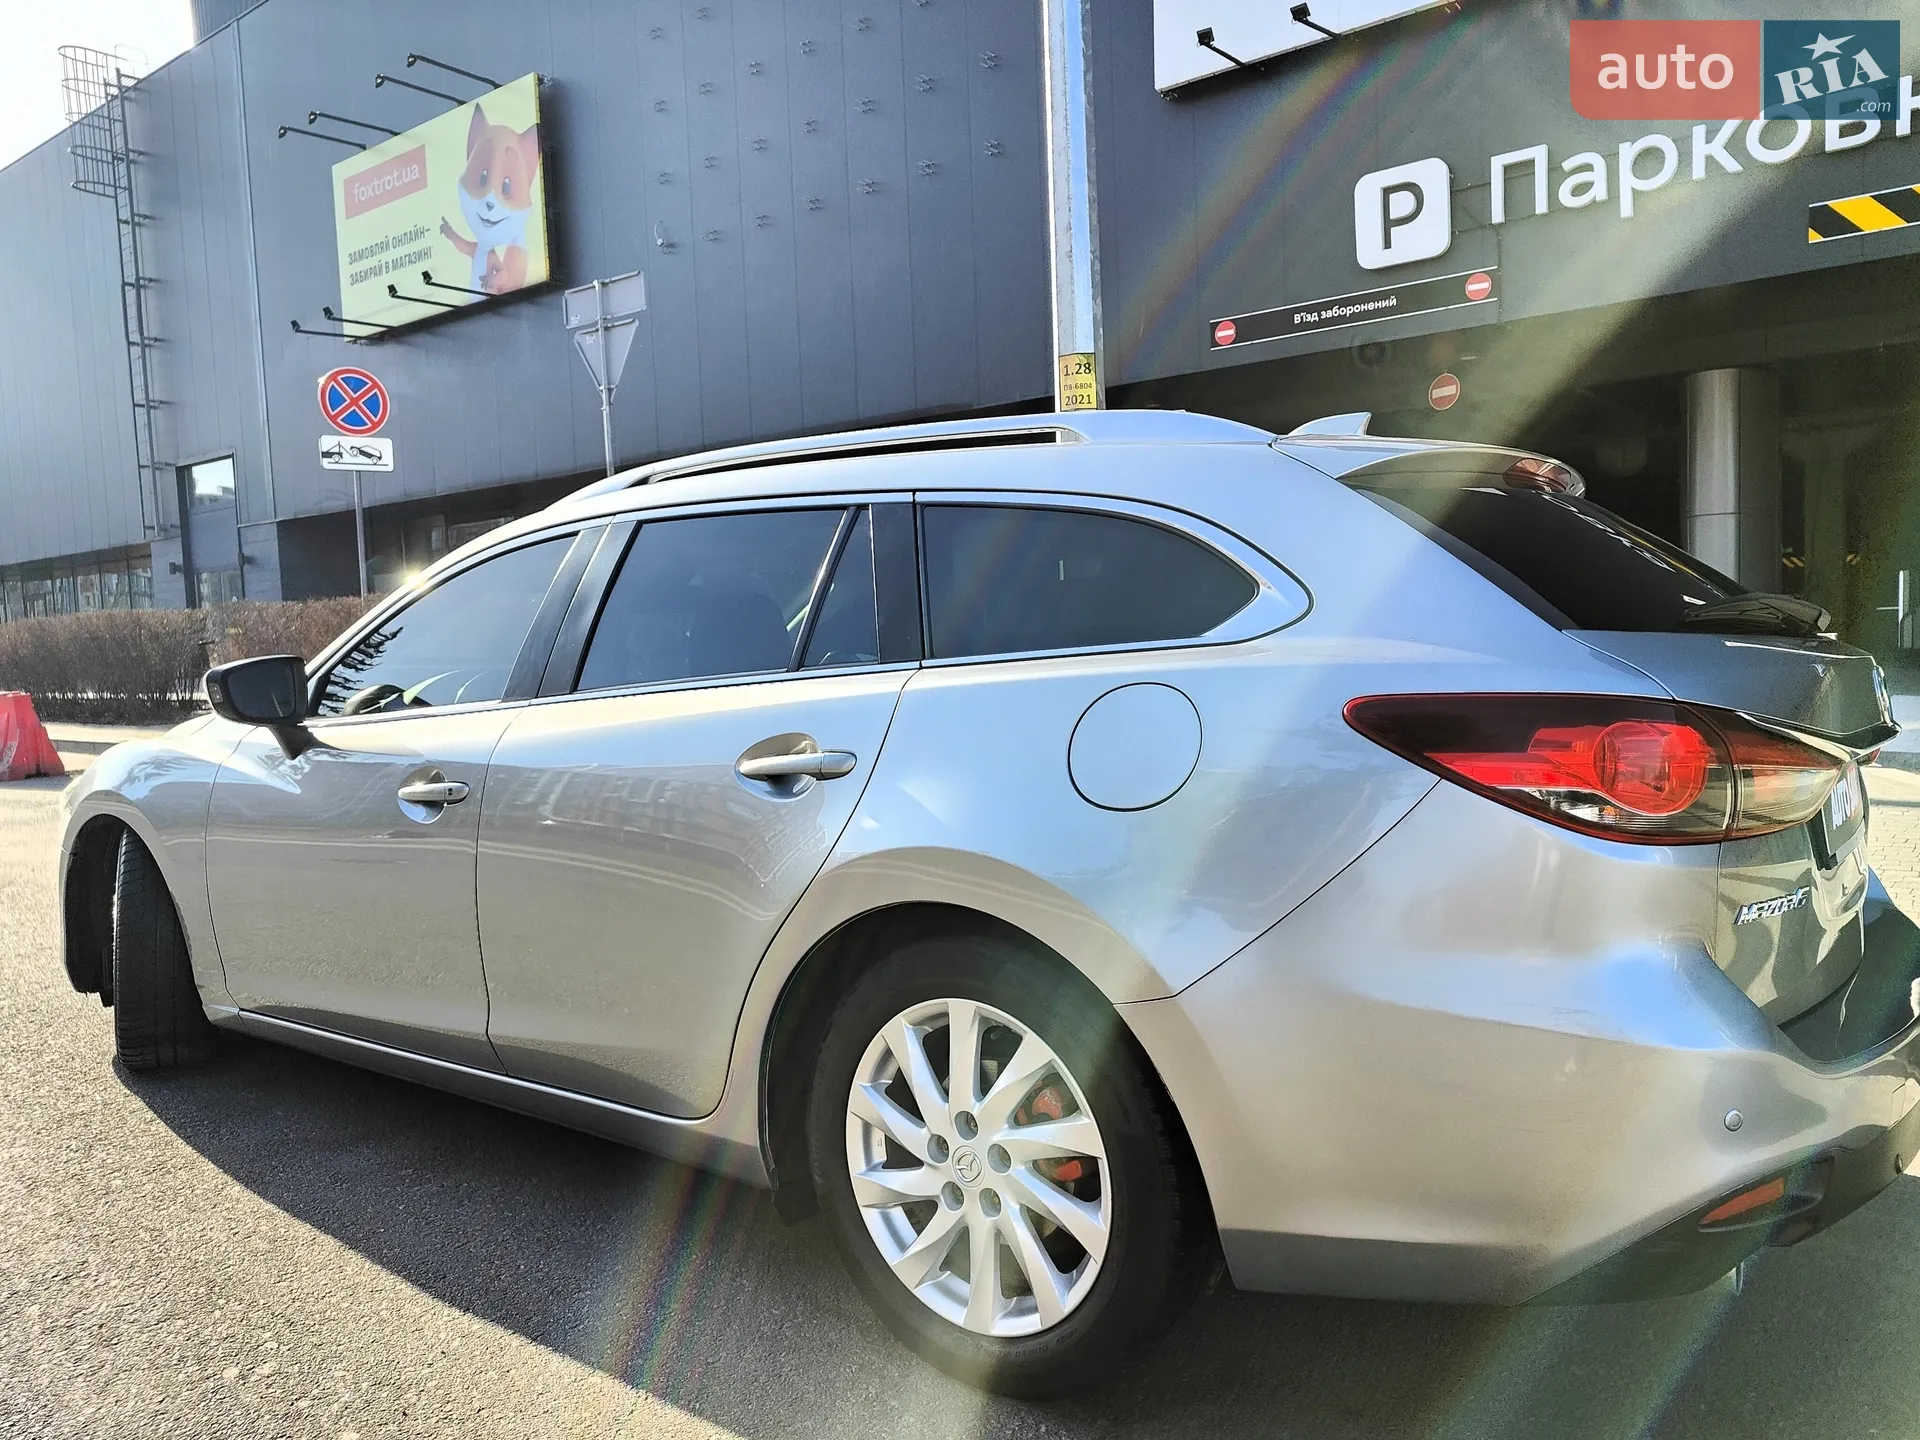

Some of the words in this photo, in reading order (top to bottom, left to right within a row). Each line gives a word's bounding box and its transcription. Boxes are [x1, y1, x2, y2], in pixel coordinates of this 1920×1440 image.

[353, 163, 420, 203] foxtrot.ua
[348, 235, 391, 265] ЗАМОВЛЯЙ
[349, 259, 384, 286] ЗАБИРАЙ
[385, 261, 391, 274] В
[391, 245, 432, 272] МАГАЗИНІ
[1320, 295, 1397, 319] заборонений
[1063, 362, 1092, 377] 1.28
[1065, 394, 1092, 406] 2021
